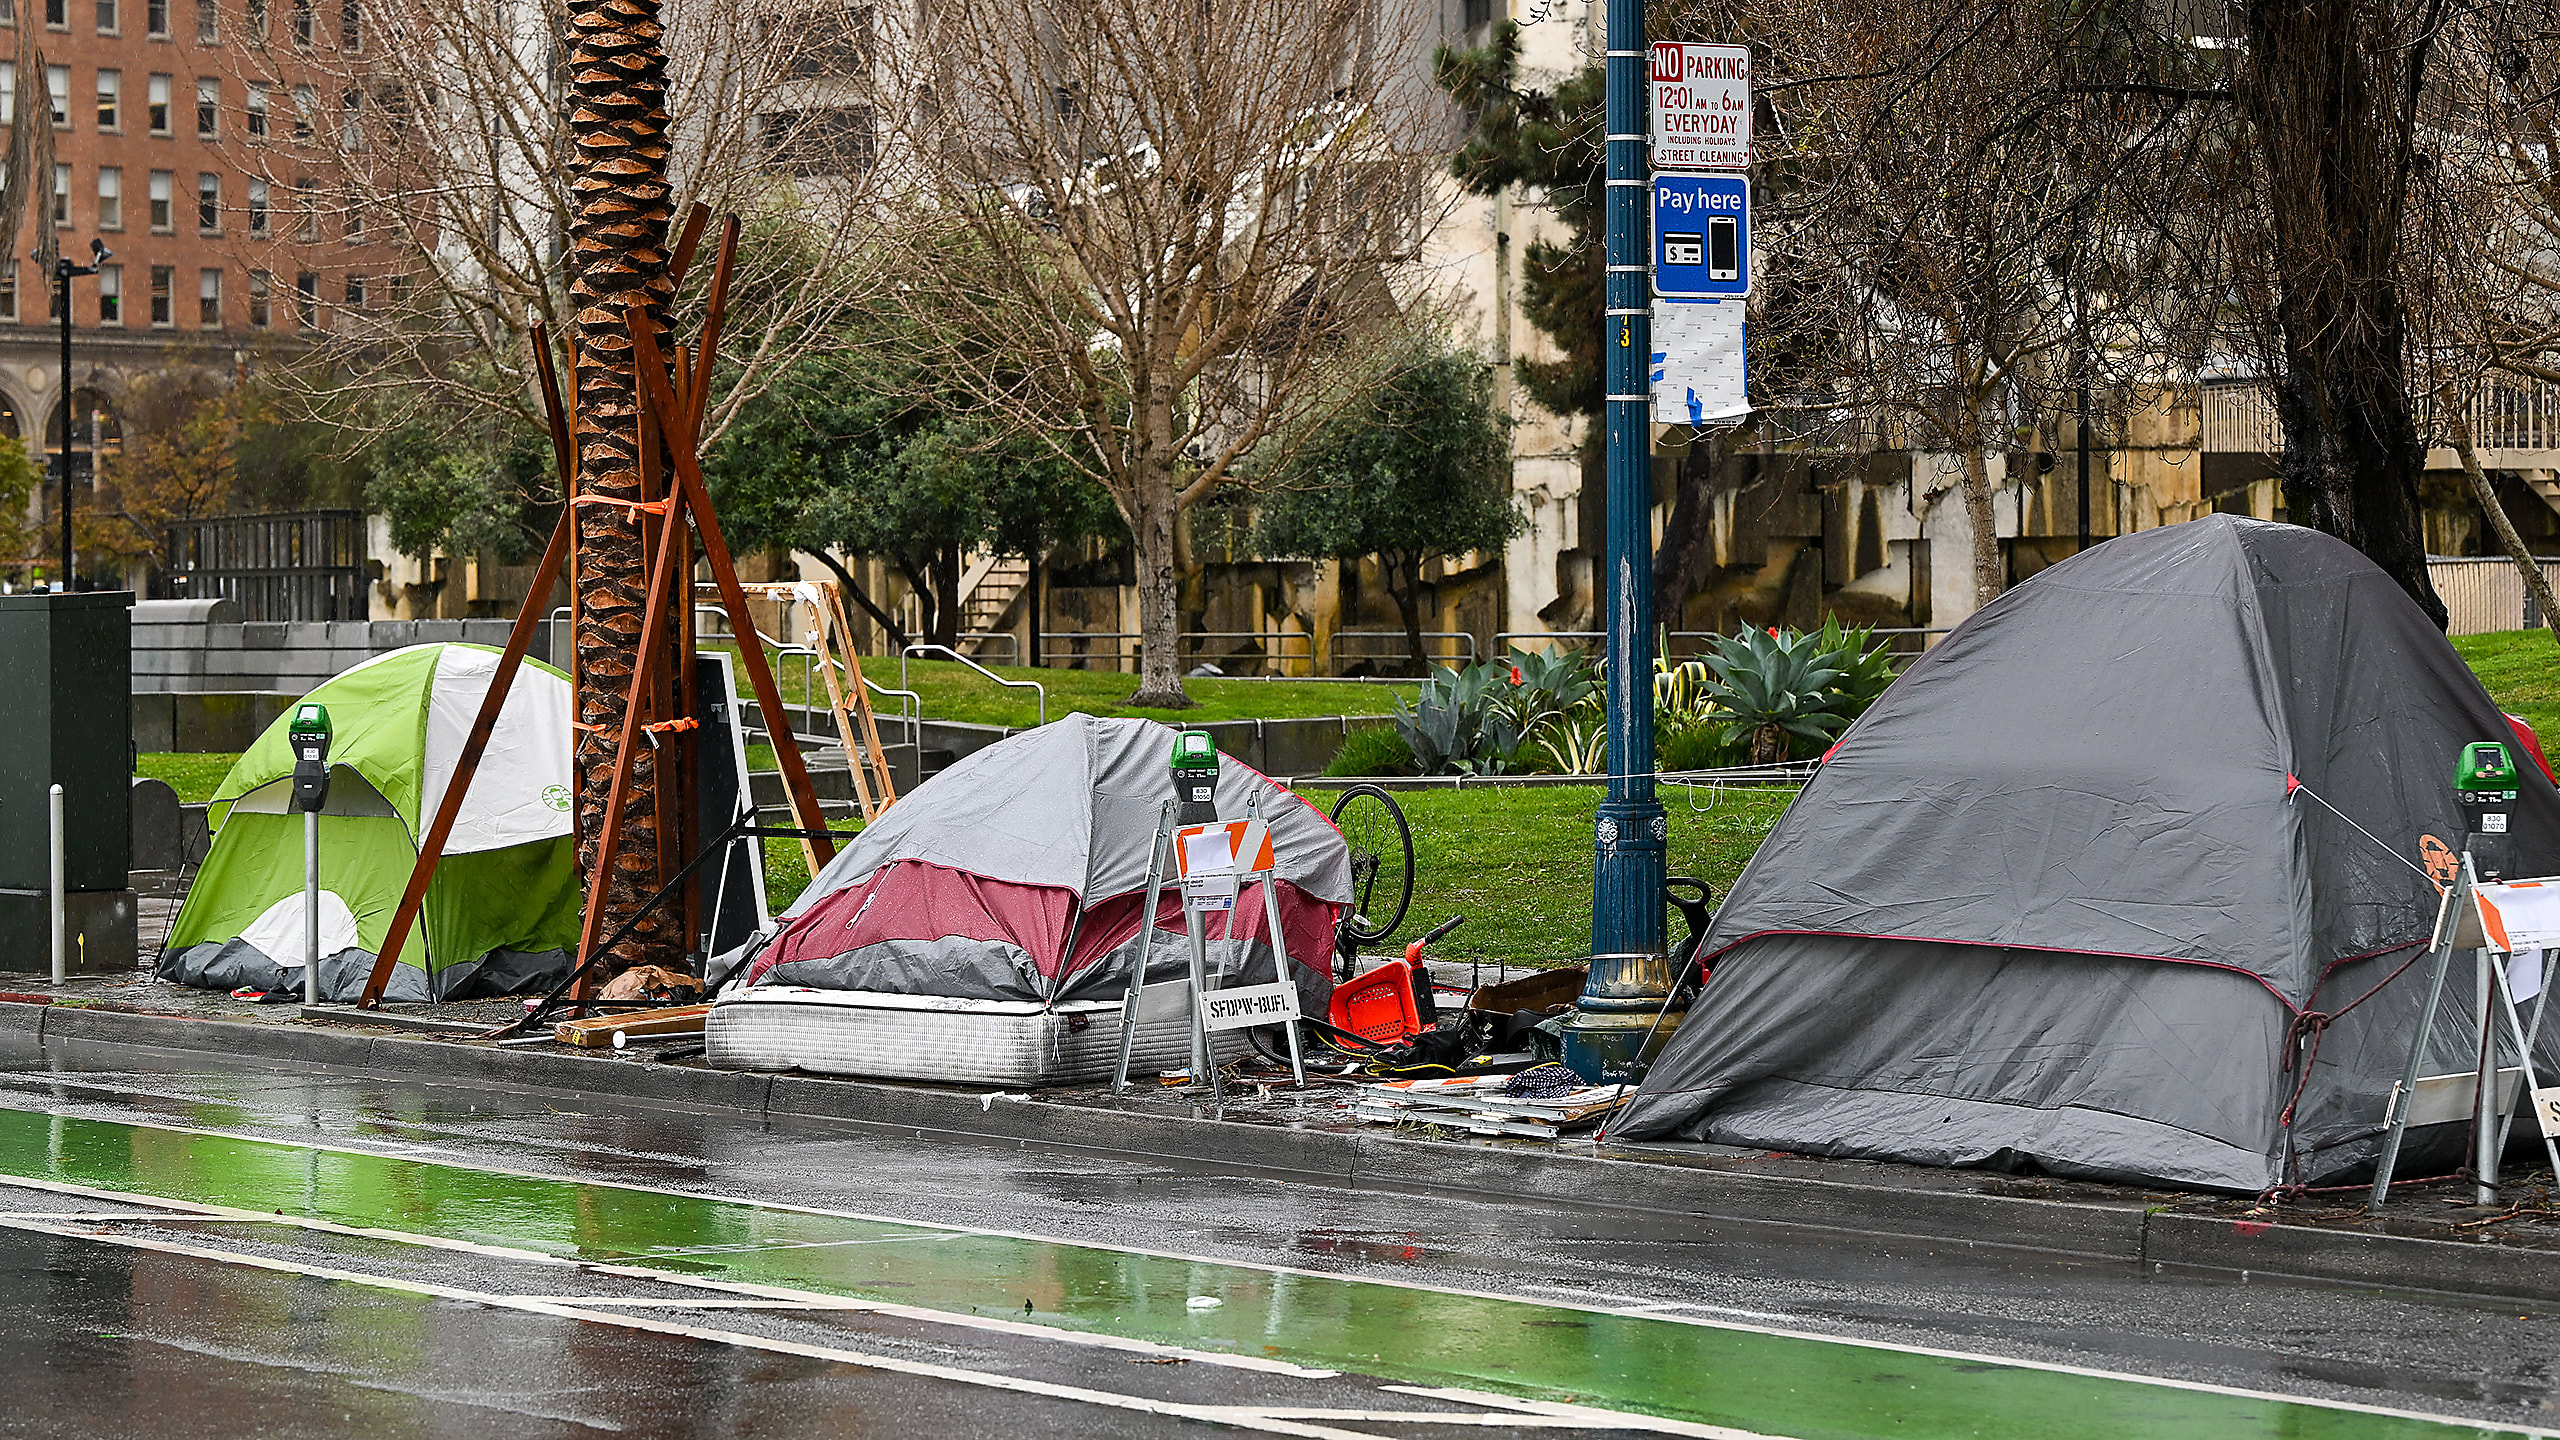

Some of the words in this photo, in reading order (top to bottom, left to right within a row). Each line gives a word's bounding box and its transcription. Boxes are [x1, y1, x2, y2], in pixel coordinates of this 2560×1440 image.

[1655, 47, 1679, 78] NO
[1687, 55, 1745, 80] PARKING
[1711, 101, 1719, 111] TO
[1665, 113, 1738, 134] EVERYDAY
[1667, 136, 1702, 145] INCLUDING
[1704, 136, 1736, 146] HOLIDAYS
[1661, 149, 1695, 162] STREET
[1700, 150, 1744, 163] CLEANING
[1659, 187, 1694, 214] Pay
[1698, 187, 1742, 210] here
